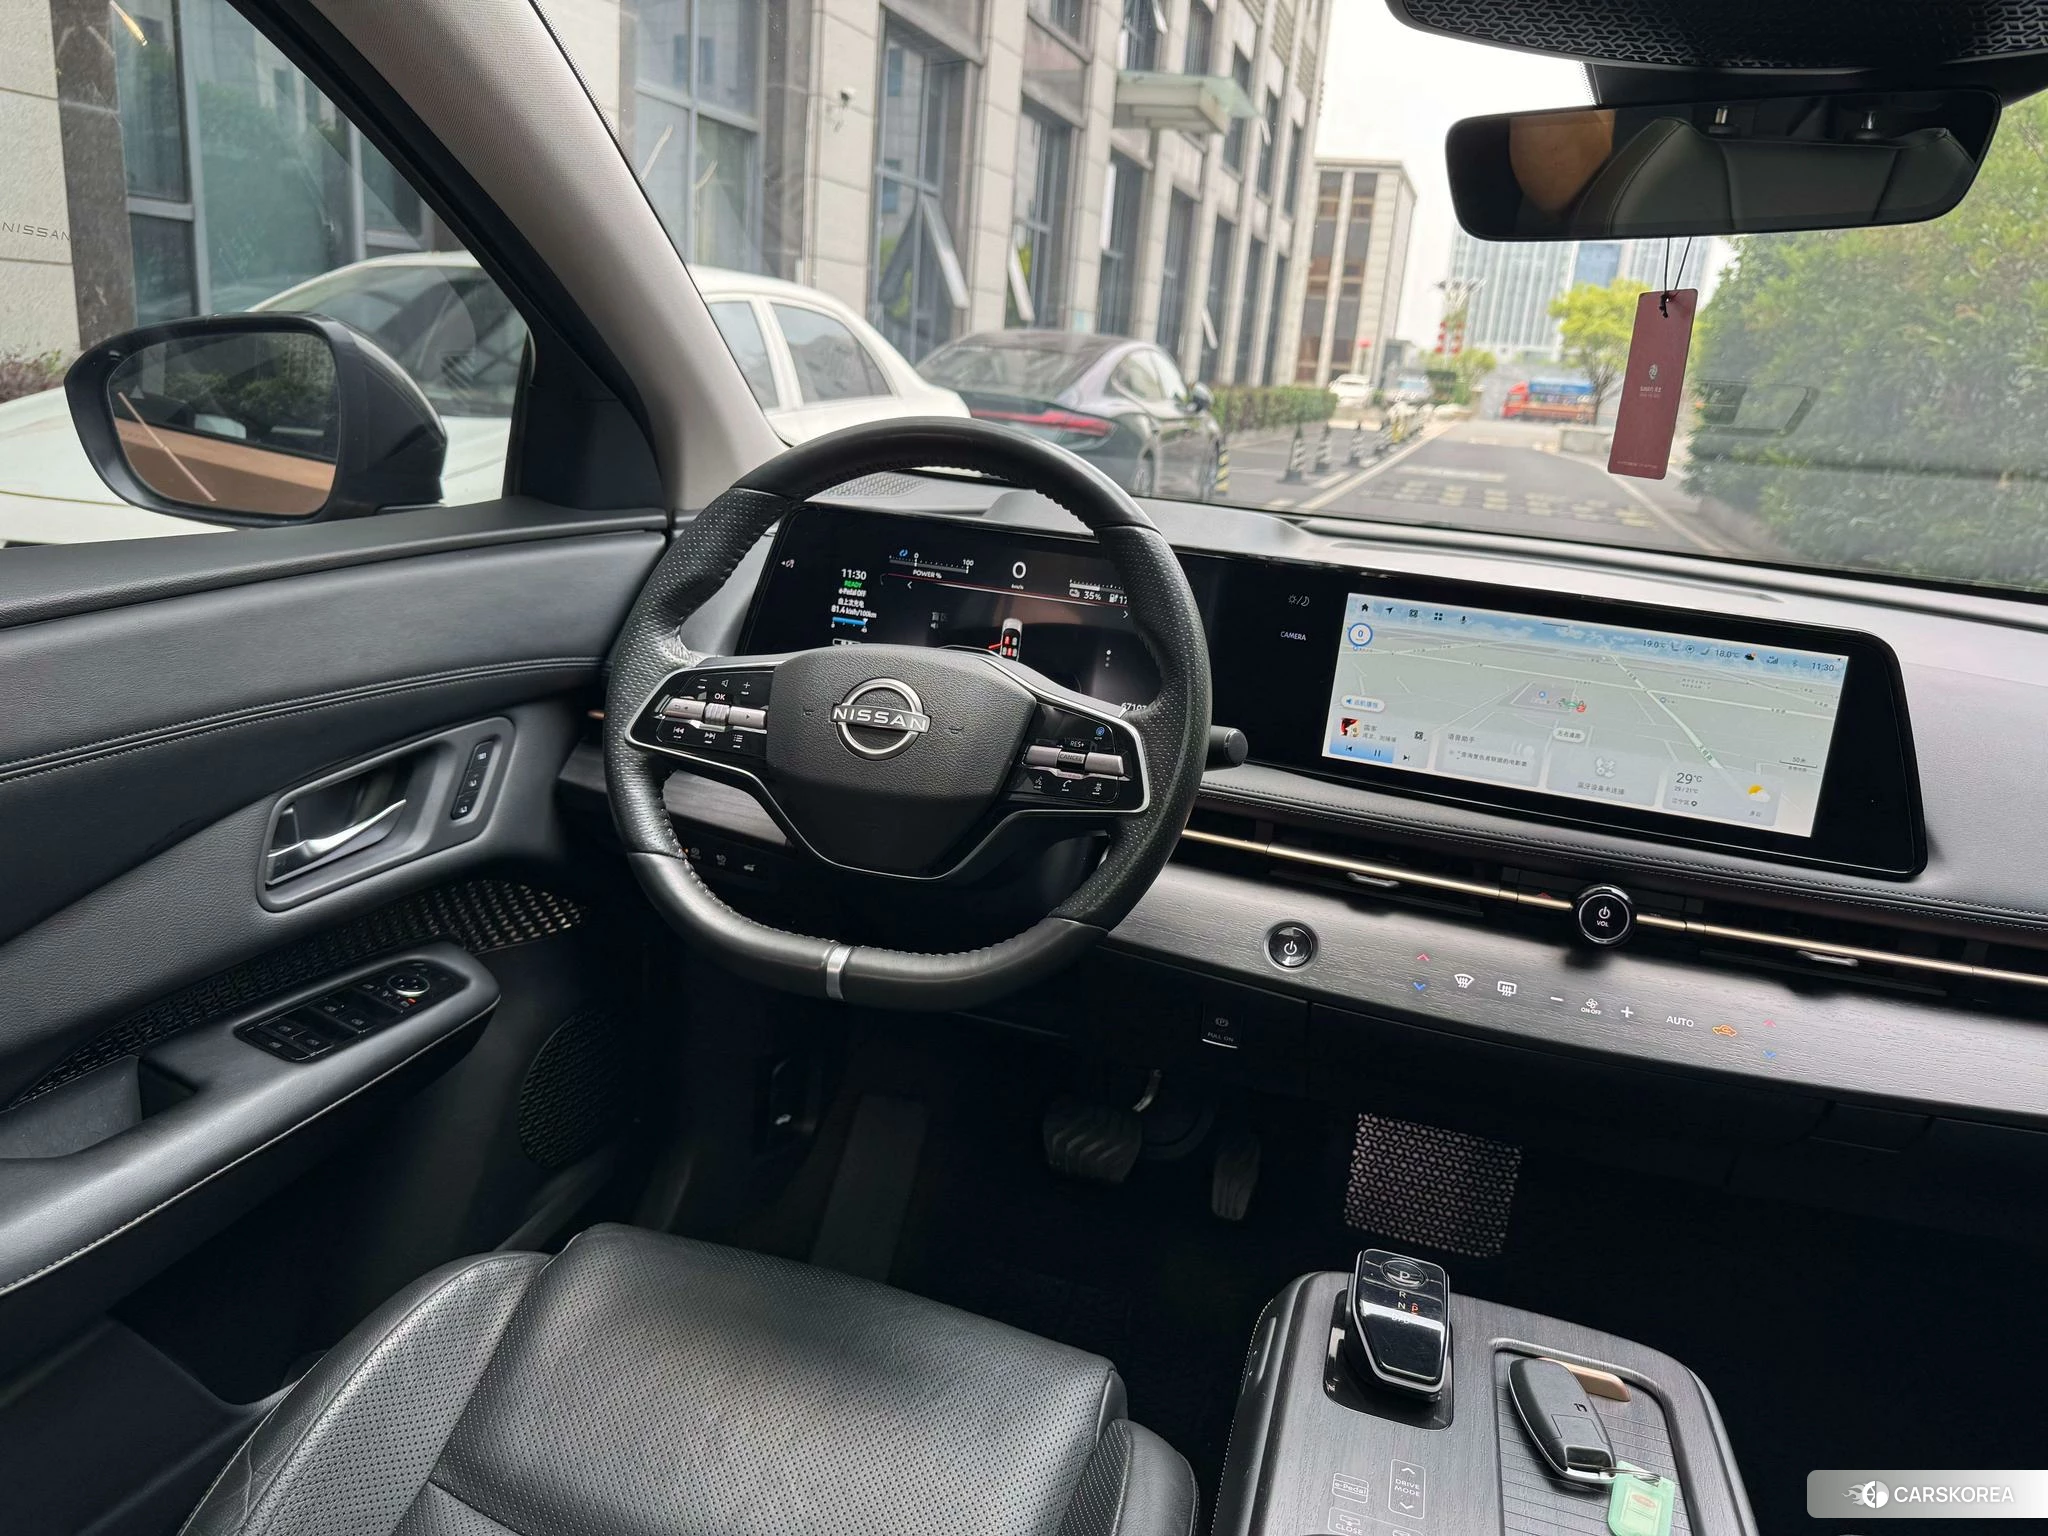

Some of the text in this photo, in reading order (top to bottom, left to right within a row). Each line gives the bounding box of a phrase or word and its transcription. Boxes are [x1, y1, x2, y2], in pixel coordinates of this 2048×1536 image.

[2, 222, 71, 241] NISSAN
[841, 568, 867, 580] 11:30
[912, 569, 935, 578] POWER
[1012, 561, 1027, 579] 0
[843, 580, 863, 588] READY
[1083, 591, 1102, 601] 35%
[1280, 631, 1307, 641] CAMERA
[1811, 662, 1835, 672] 11:30
[714, 692, 726, 701] OK
[833, 707, 926, 731] NISSAN
[1069, 740, 1085, 748] RES+
[1059, 753, 1083, 762] CANCEL
[1596, 920, 1609, 928] VOL
[1666, 1015, 1694, 1028] AUTO
[1399, 1291, 1407, 1299] R
[1397, 1302, 1406, 1310] N
[1334, 1481, 1367, 1495] e-Pedal
[1394, 1478, 1421, 1490] DRIVE
[1394, 1485, 1421, 1497] MODE
[1335, 1522, 1363, 1536] CLOSE
